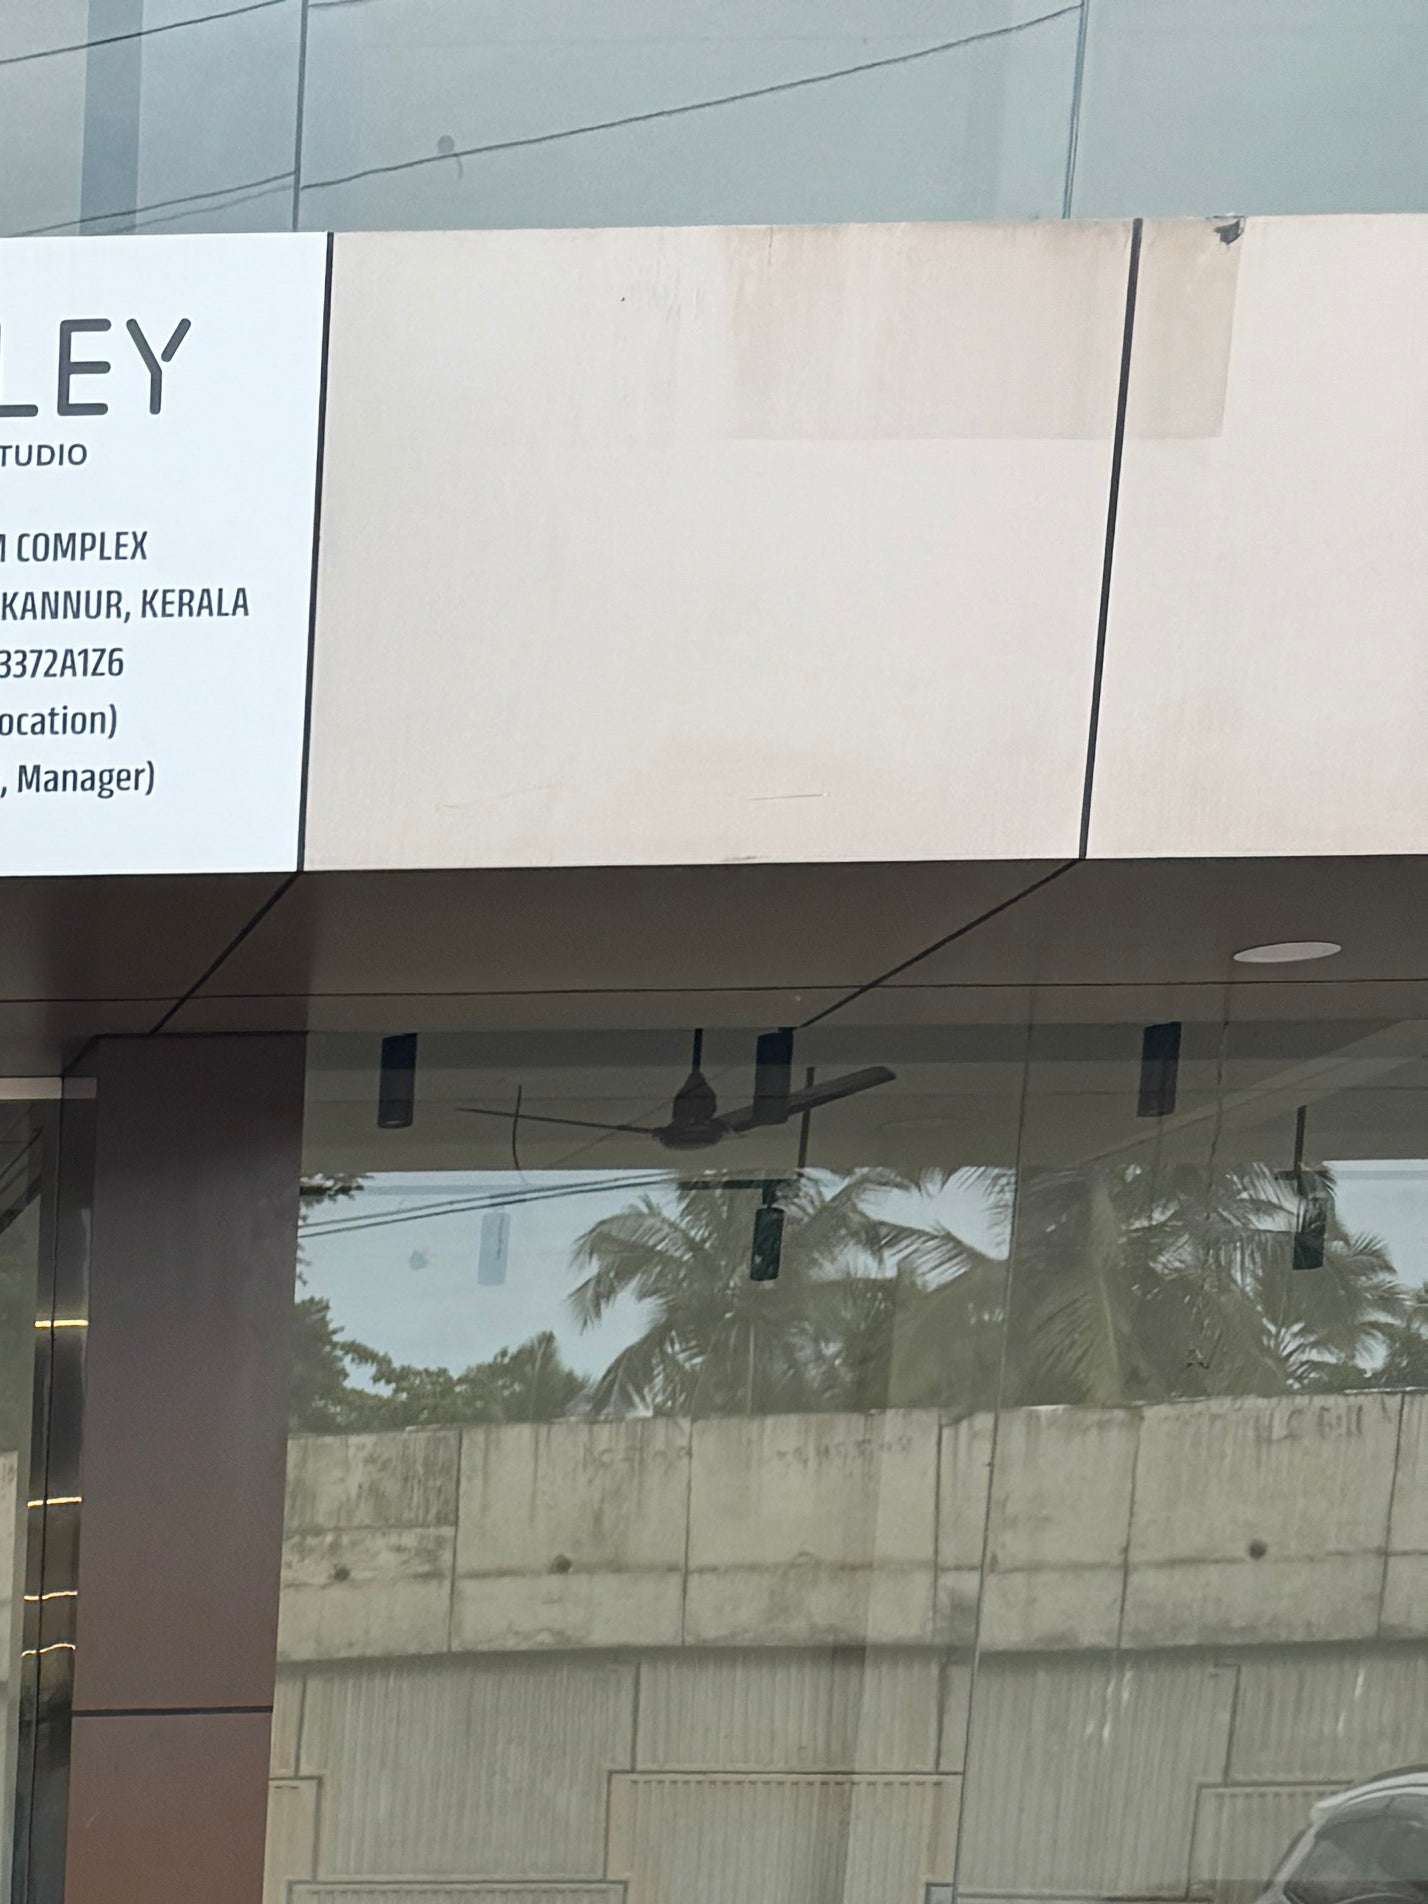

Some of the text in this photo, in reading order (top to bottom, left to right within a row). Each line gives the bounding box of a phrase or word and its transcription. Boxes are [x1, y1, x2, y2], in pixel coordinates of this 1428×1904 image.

[16, 530, 148, 563] COMPLEX
[1, 589, 131, 624] KANNUR,
[141, 587, 249, 619] KERALA
[17, 760, 155, 799] Manager)
